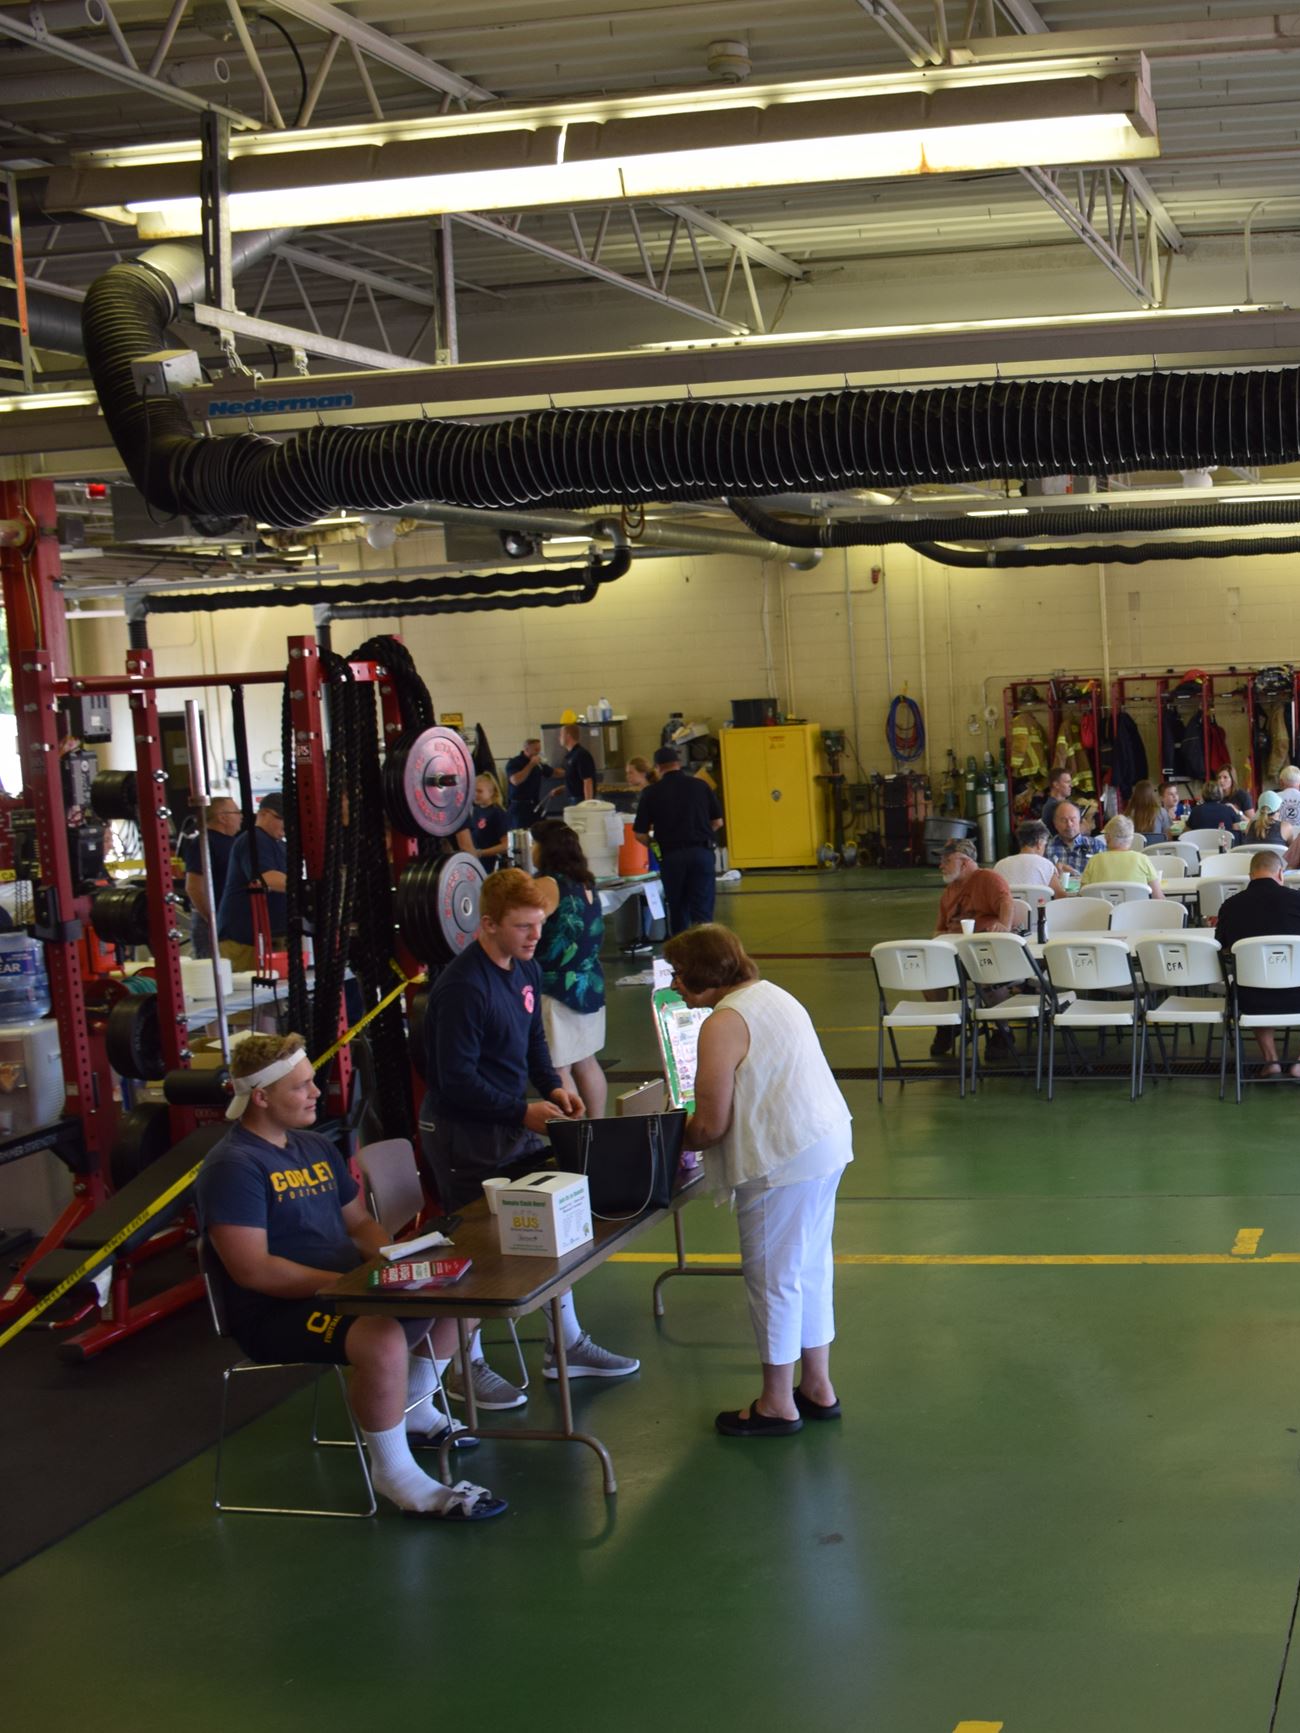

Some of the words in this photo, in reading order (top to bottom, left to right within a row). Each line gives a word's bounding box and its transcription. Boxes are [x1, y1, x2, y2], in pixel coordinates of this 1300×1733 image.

[208, 393, 354, 417] Nederman
[1074, 958, 1094, 968] CFA
[1268, 954, 1288, 965] CFA
[1166, 961, 1184, 972] CFA
[270, 1161, 335, 1193] COPLEY
[512, 1216, 540, 1229] BUS
[306, 1311, 331, 1334] C
